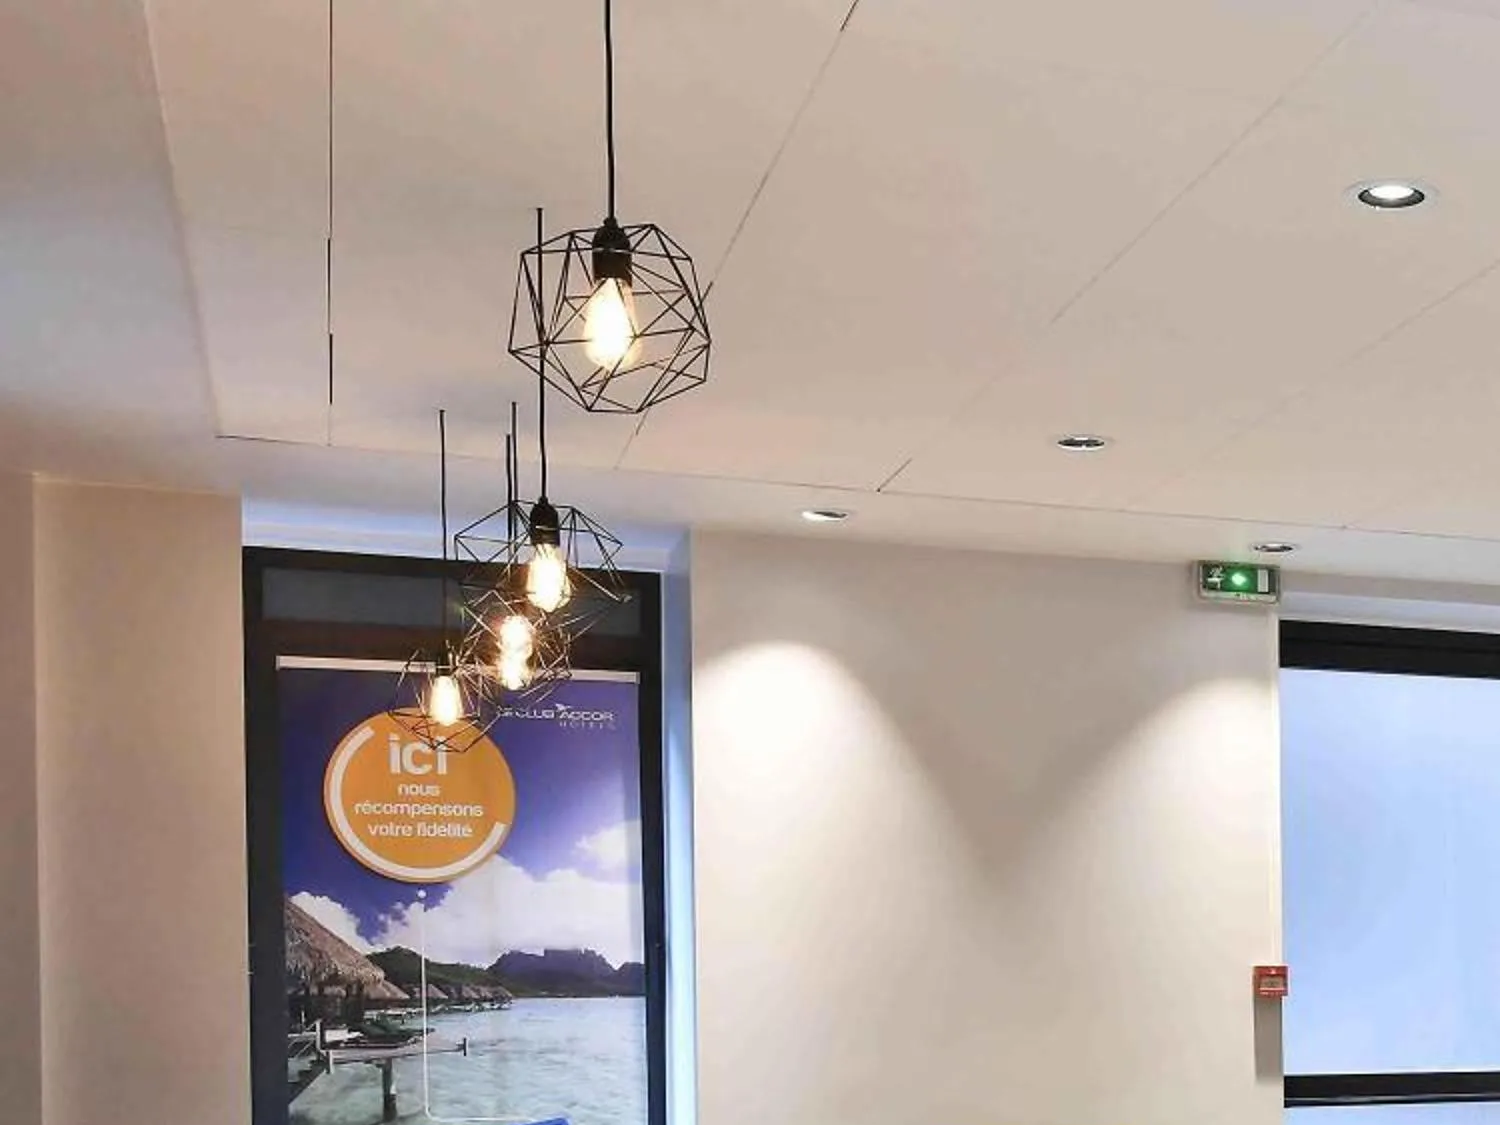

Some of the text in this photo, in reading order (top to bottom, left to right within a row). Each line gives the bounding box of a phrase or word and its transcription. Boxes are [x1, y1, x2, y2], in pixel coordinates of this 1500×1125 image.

[559, 711, 615, 721] ACCOR
[388, 732, 448, 775] ici
[398, 783, 441, 796] nous
[354, 800, 484, 818] récompensons
[367, 821, 413, 837] votre
